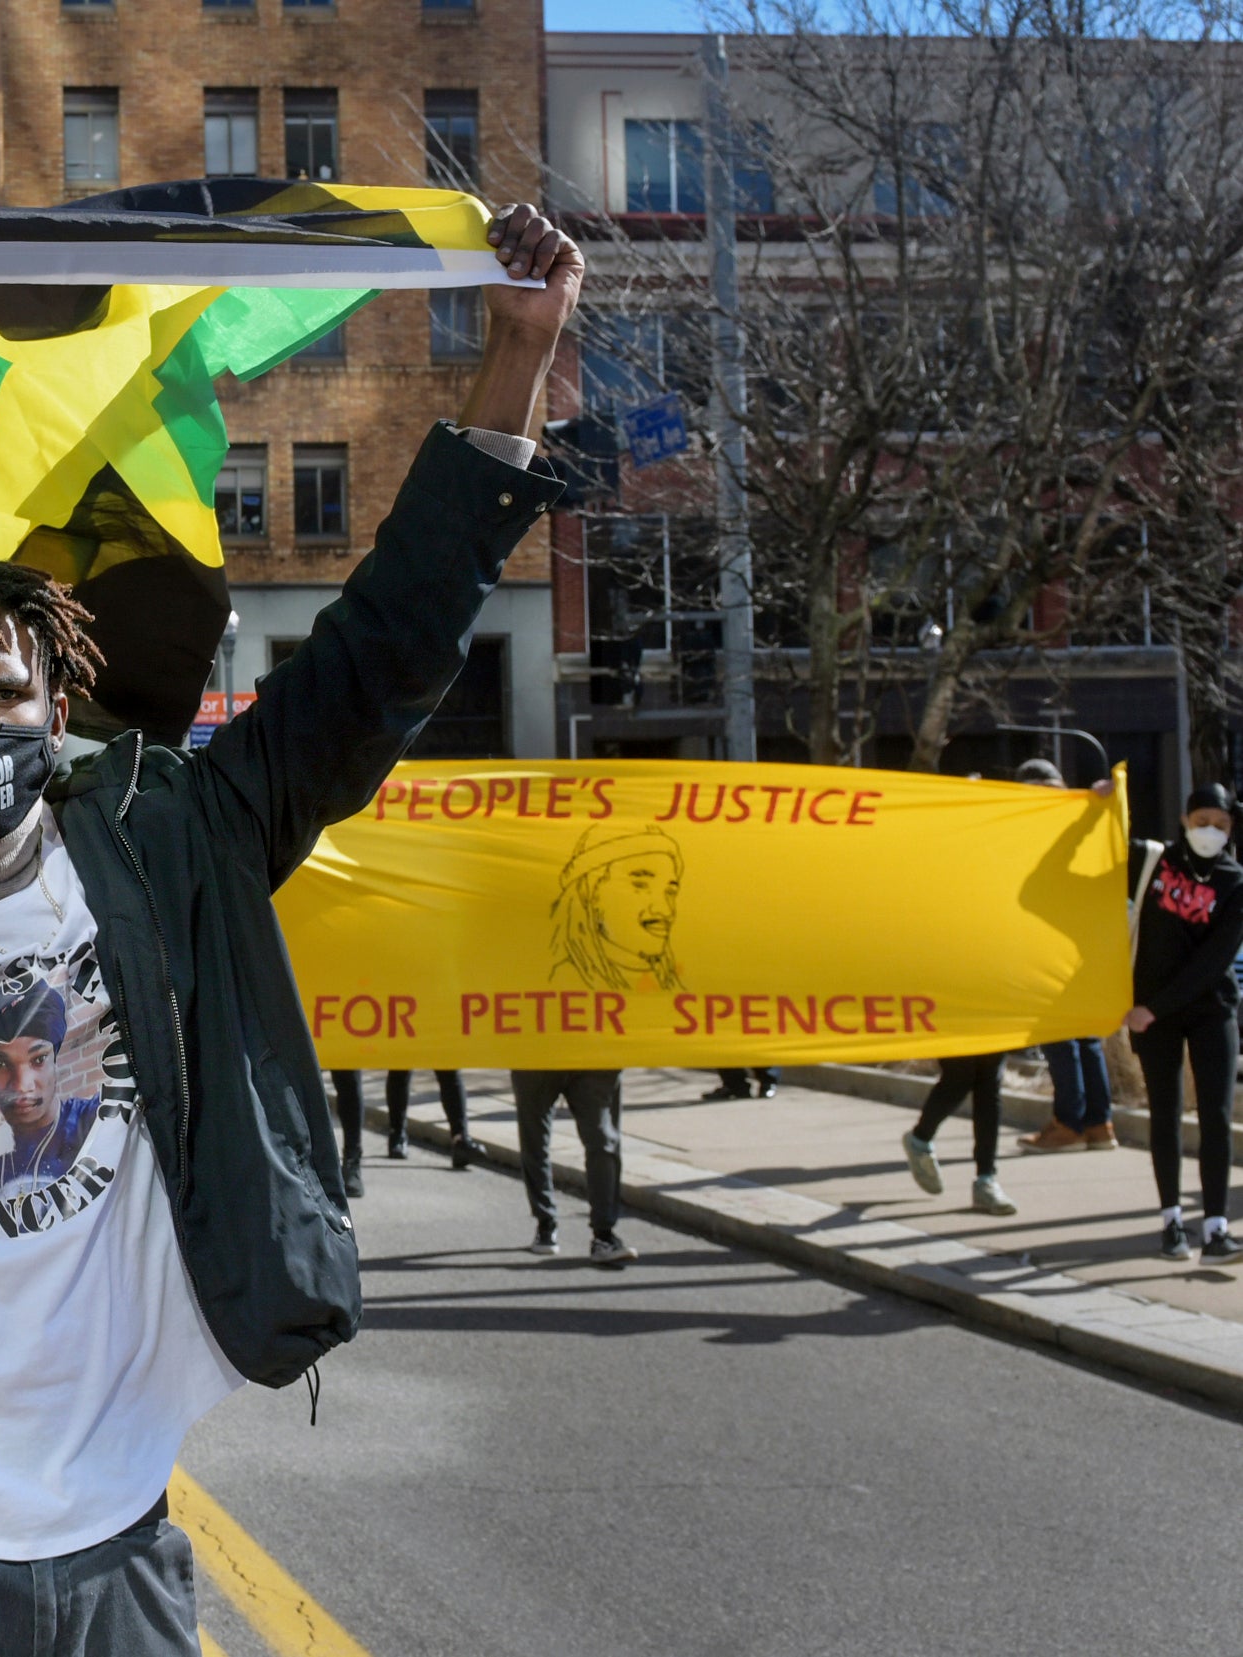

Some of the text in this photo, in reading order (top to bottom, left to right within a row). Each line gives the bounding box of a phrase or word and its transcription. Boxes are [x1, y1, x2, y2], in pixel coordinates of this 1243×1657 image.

[201, 701, 218, 713] or
[375, 777, 883, 825] PEOPLE'S JUSTICE
[313, 991, 937, 1039] FOR PETER SPENCER
